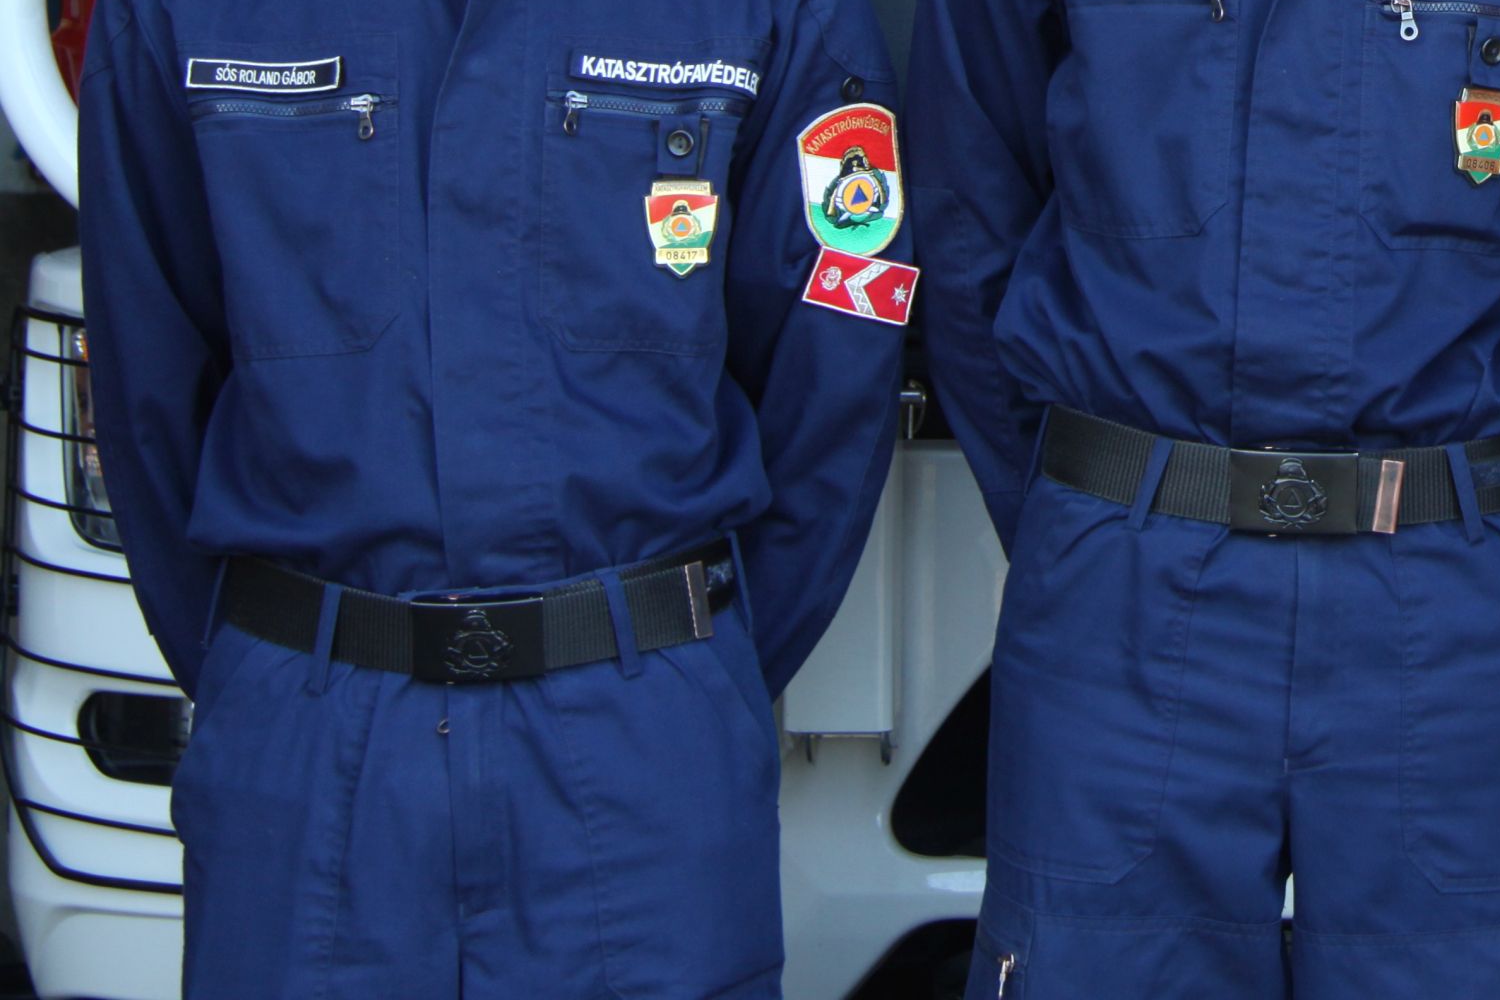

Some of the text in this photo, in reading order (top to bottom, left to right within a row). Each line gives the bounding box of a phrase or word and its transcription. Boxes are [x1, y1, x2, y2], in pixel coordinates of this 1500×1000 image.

[215, 63, 316, 86] SÓS ROLAND GÁBOR
[581, 55, 762, 97] KATASZTRÓFAVÉDELE
[666, 250, 698, 261] 08417
